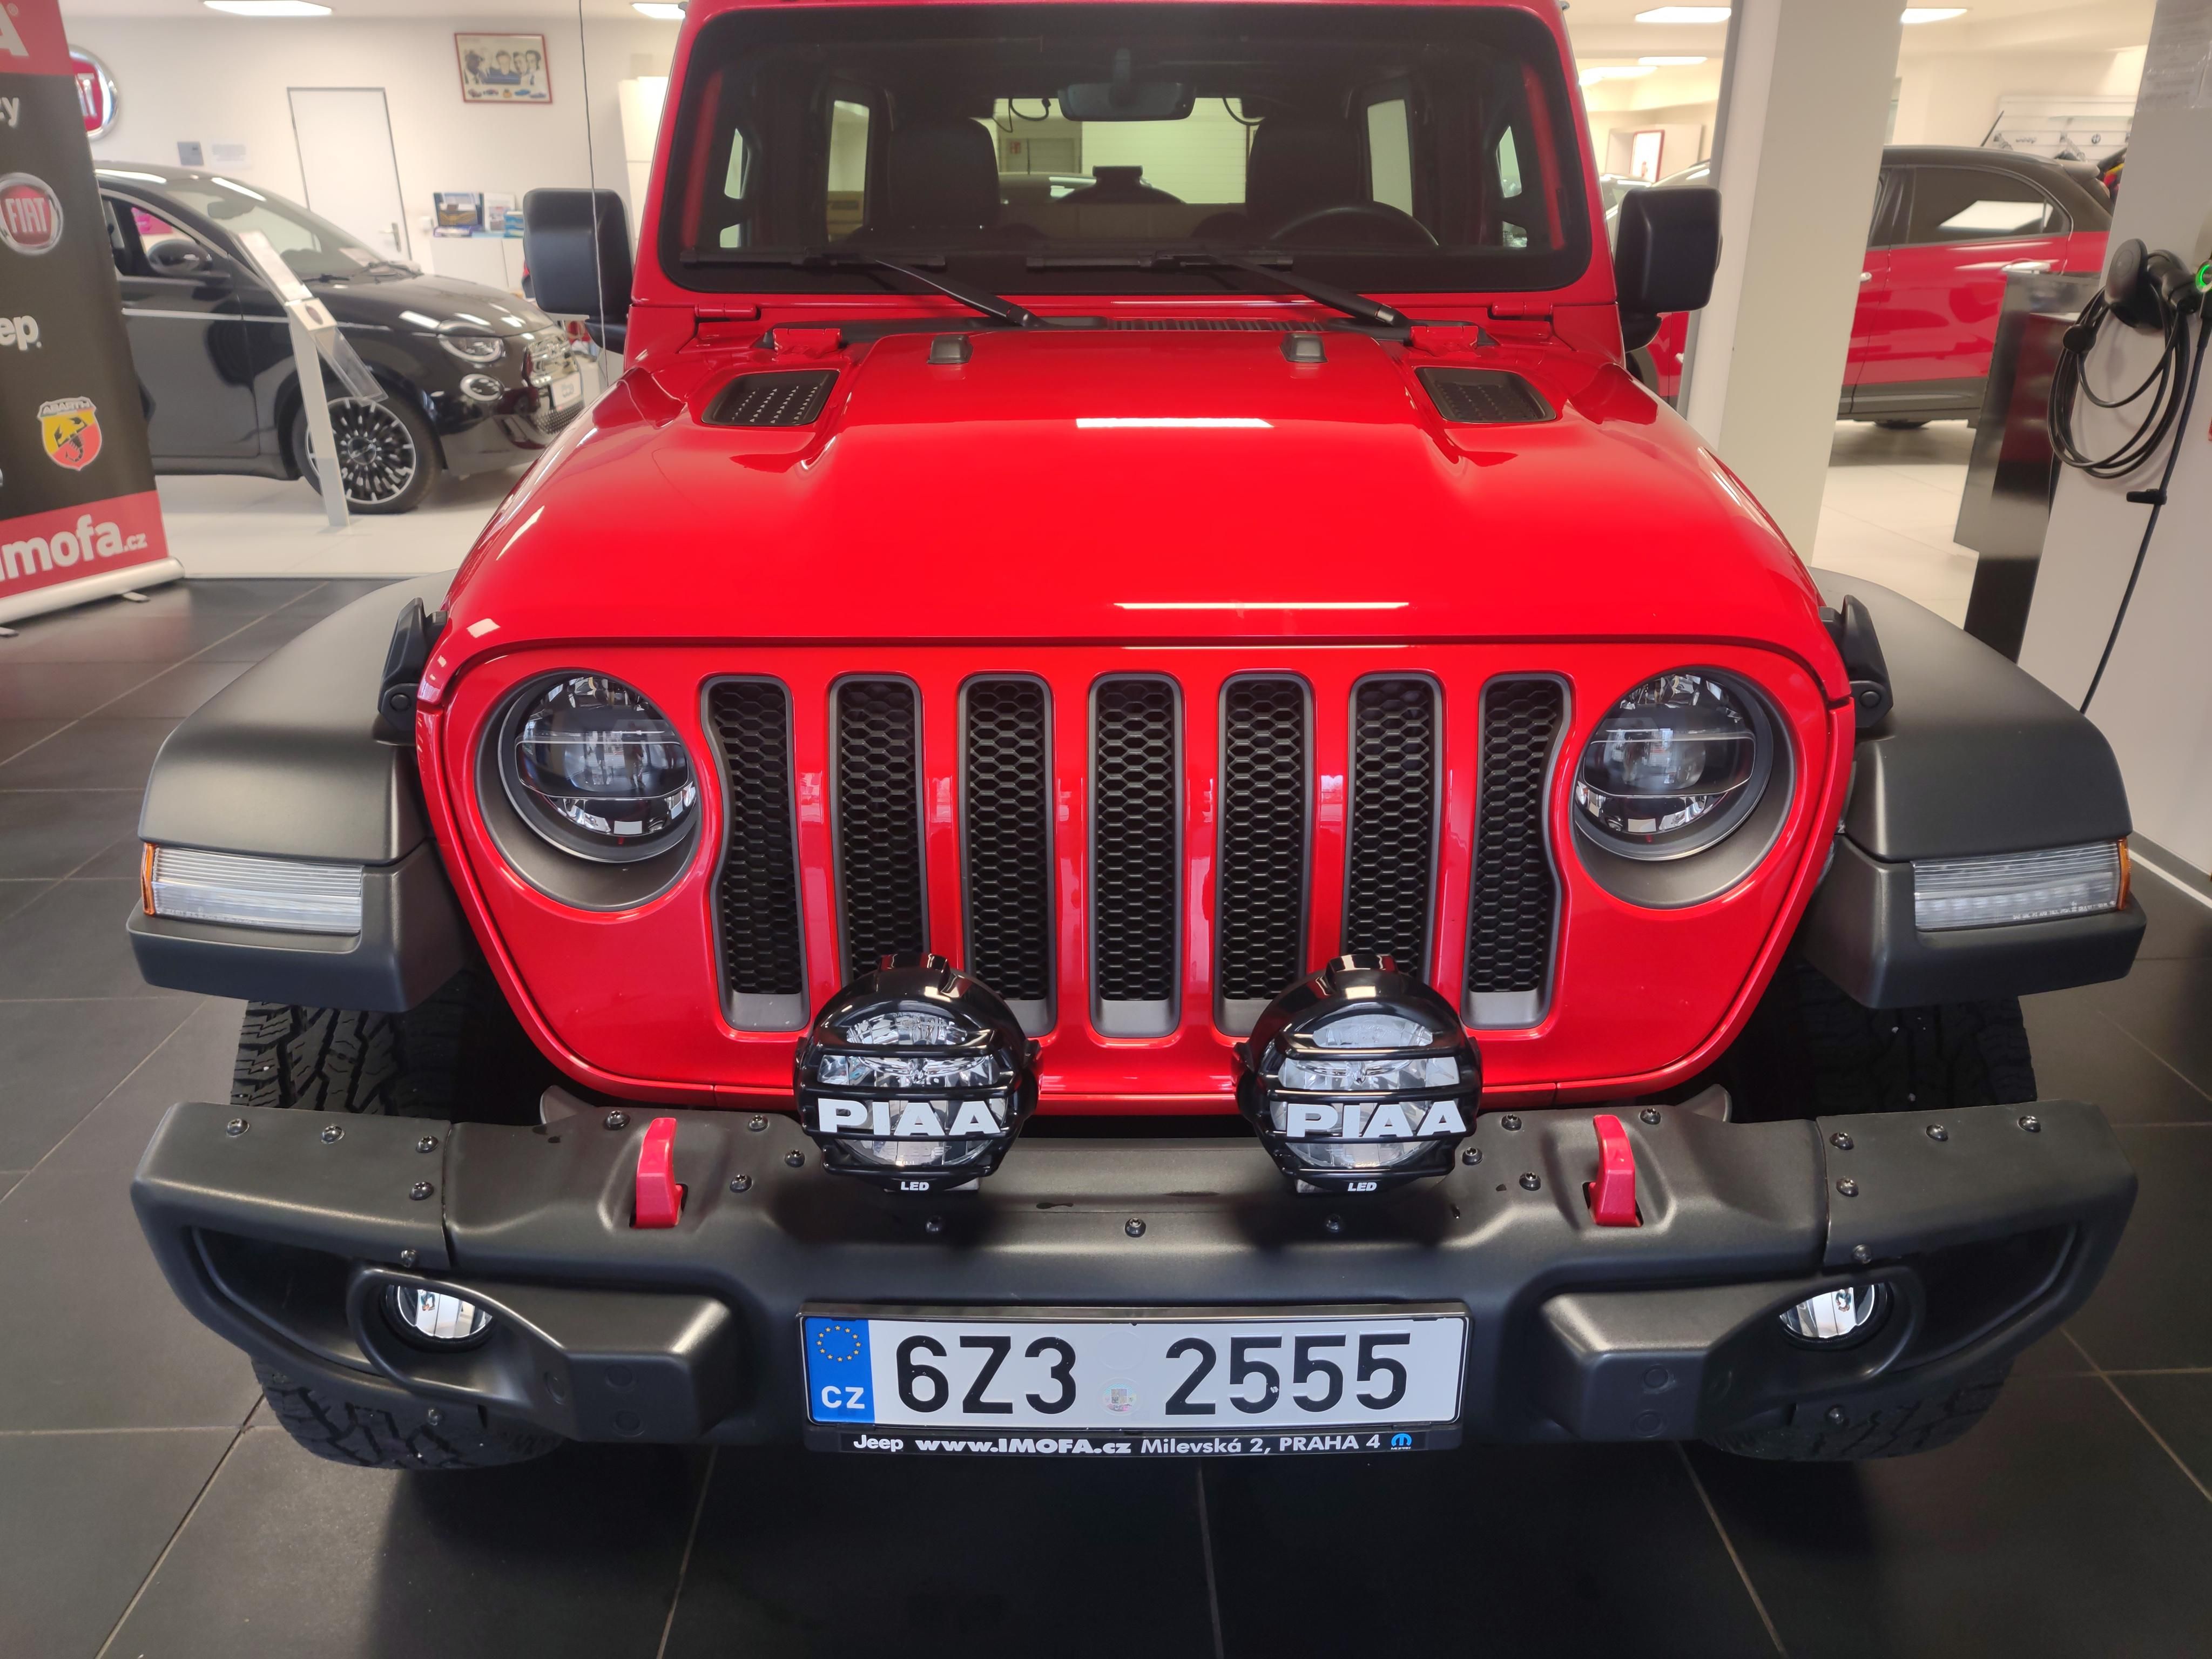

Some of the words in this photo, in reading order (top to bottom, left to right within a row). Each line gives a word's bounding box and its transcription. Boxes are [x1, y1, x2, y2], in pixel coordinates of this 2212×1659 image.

[5, 197, 48, 234] FIAT
[818, 1098, 1001, 1136] PIAA
[1286, 1100, 1467, 1138] PIAA
[901, 1182, 929, 1191] LED
[1347, 1182, 1377, 1192] LED
[896, 1334, 1076, 1415] 6Z3
[1165, 1332, 1411, 1415] 2555
[821, 1385, 865, 1410] CZ
[853, 1434, 904, 1452] Jeep
[915, 1438, 1131, 1454] www.IMOFA.cz
[1141, 1438, 1242, 1453] Milevská
[1250, 1438, 1271, 1455] 2,
[1279, 1435, 1359, 1452] PRAHA
[1366, 1434, 1380, 1448] 4
